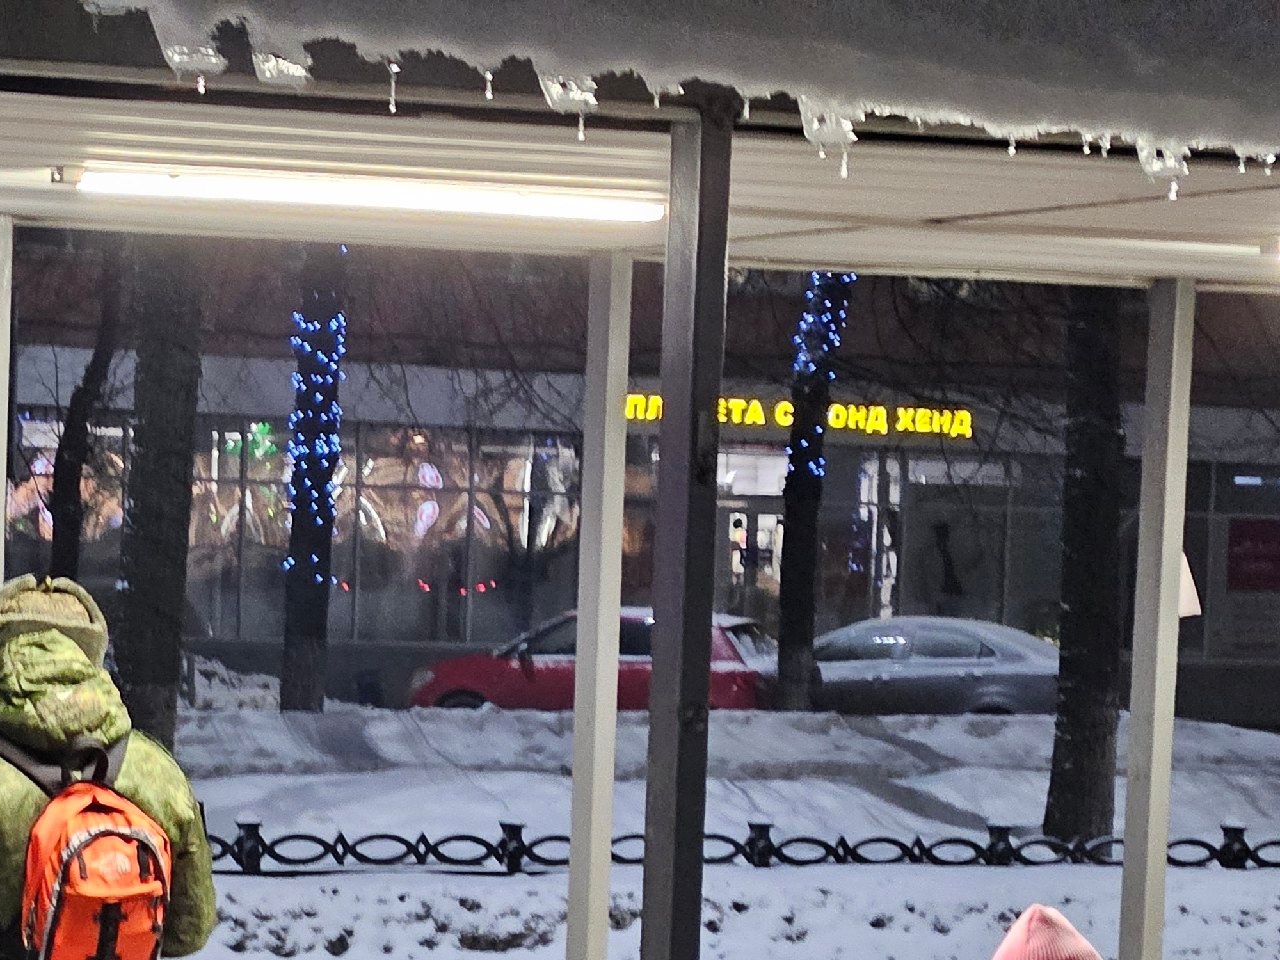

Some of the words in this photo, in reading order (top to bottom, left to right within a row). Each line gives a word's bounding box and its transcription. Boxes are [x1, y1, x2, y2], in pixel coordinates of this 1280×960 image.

[624, 393, 766, 425] ПЛЕТА
[774, 400, 889, 435] СОНД
[895, 407, 973, 439] ХЕНД
